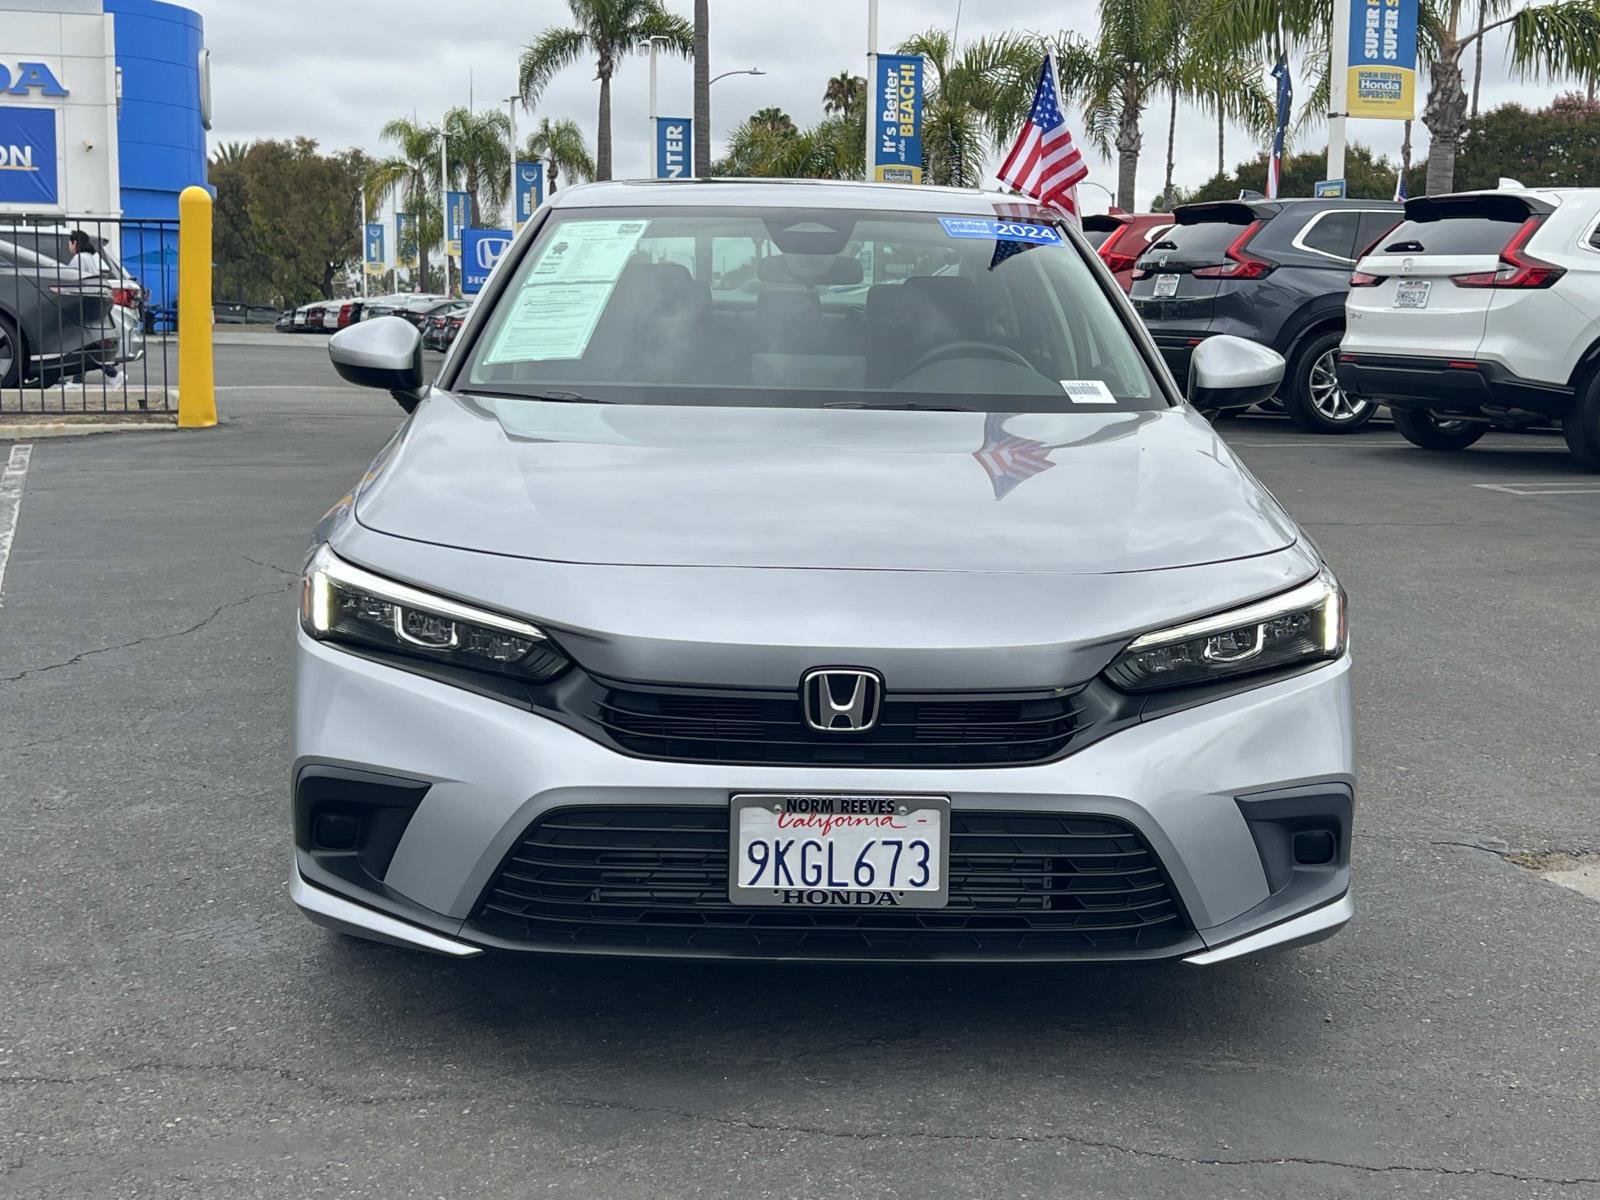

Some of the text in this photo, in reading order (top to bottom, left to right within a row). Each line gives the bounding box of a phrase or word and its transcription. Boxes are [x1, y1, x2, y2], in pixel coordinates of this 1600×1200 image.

[1364, 8, 1380, 59] SUPER
[1383, 9, 1399, 60] SUPER
[0, 62, 69, 97] A
[1361, 80, 1400, 90] Honda
[883, 68, 898, 153] It's Better
[900, 64, 915, 137] BEACH!
[993, 222, 1057, 241] 2024
[786, 798, 895, 814] NORM REEVES
[777, 812, 907, 837] California
[747, 839, 930, 888] 9KGL673
[781, 889, 900, 906] HONDA
